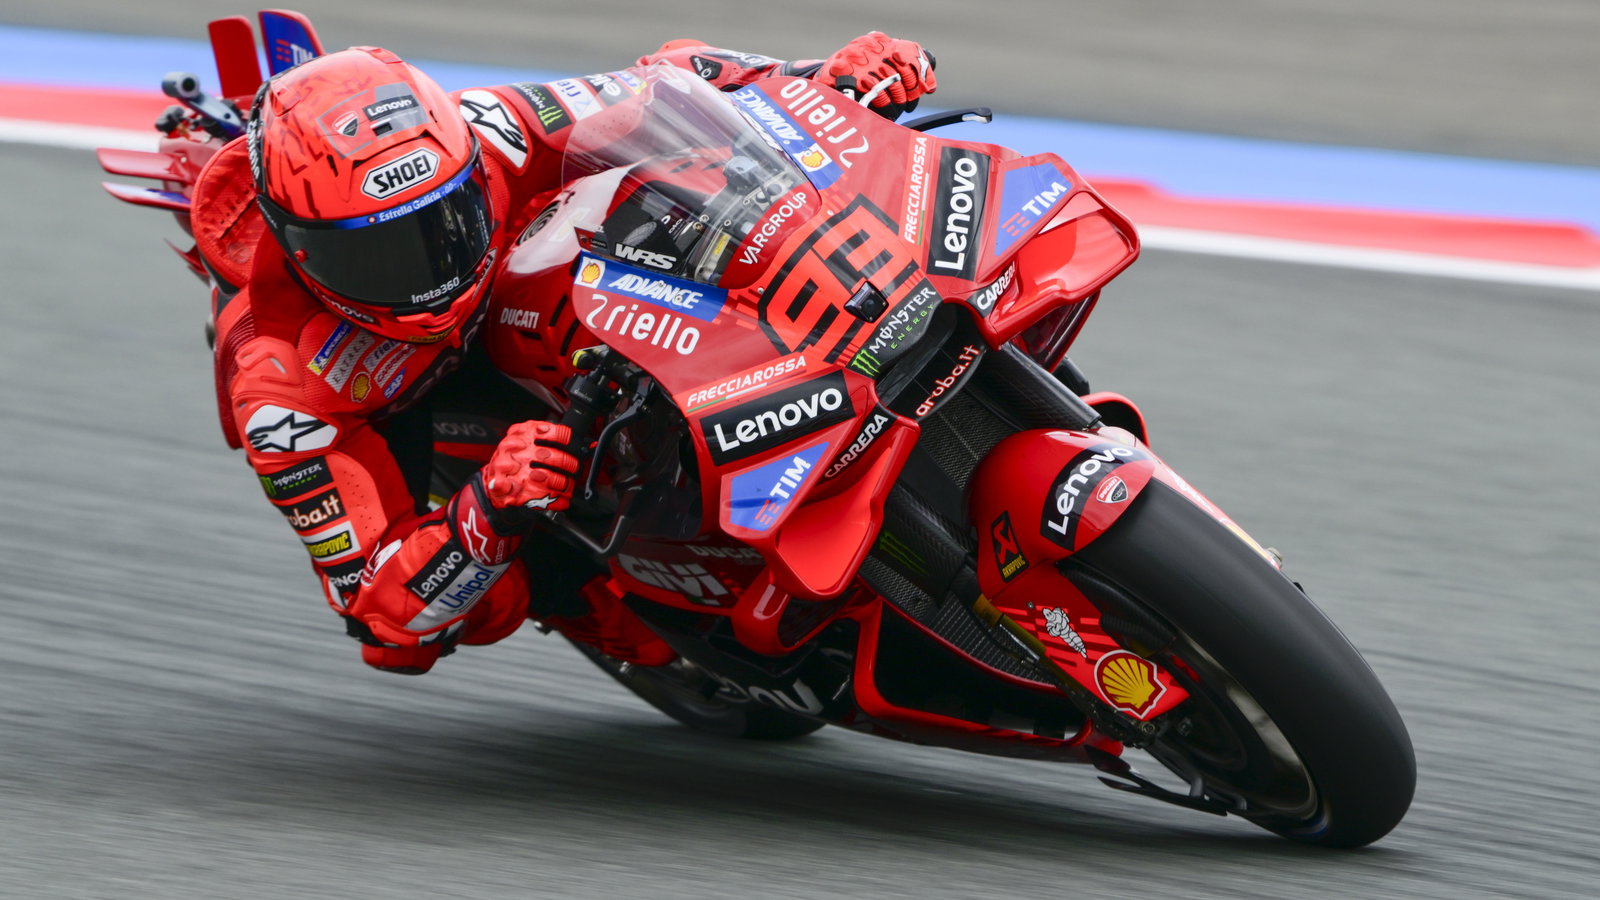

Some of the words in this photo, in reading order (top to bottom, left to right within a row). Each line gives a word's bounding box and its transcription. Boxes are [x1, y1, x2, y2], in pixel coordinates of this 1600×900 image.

[373, 154, 431, 193] SHOEI
[903, 137, 927, 245] FRECCIAROSSA
[379, 206, 413, 223] Estrella
[413, 191, 442, 211] Galicia
[935, 157, 978, 271] Lenovo
[1021, 182, 1067, 217] TIM
[739, 191, 807, 265] VARGROUP
[615, 243, 677, 270] WRS
[411, 276, 460, 304] Insta360
[608, 273, 703, 309] ADVANCE
[500, 307, 540, 330] DUCATI
[869, 287, 936, 354] MONSTER
[890, 302, 935, 350] ENERGY
[687, 356, 807, 408] FRECCIAROSSA
[915, 344, 980, 417] aruba.it
[714, 387, 842, 452] Lenovo
[824, 413, 889, 479] CARRERA
[769, 456, 811, 500] TIM
[1047, 445, 1134, 536] Lenovo
[412, 551, 463, 600] Lenovo
[439, 564, 495, 609] Unipol
